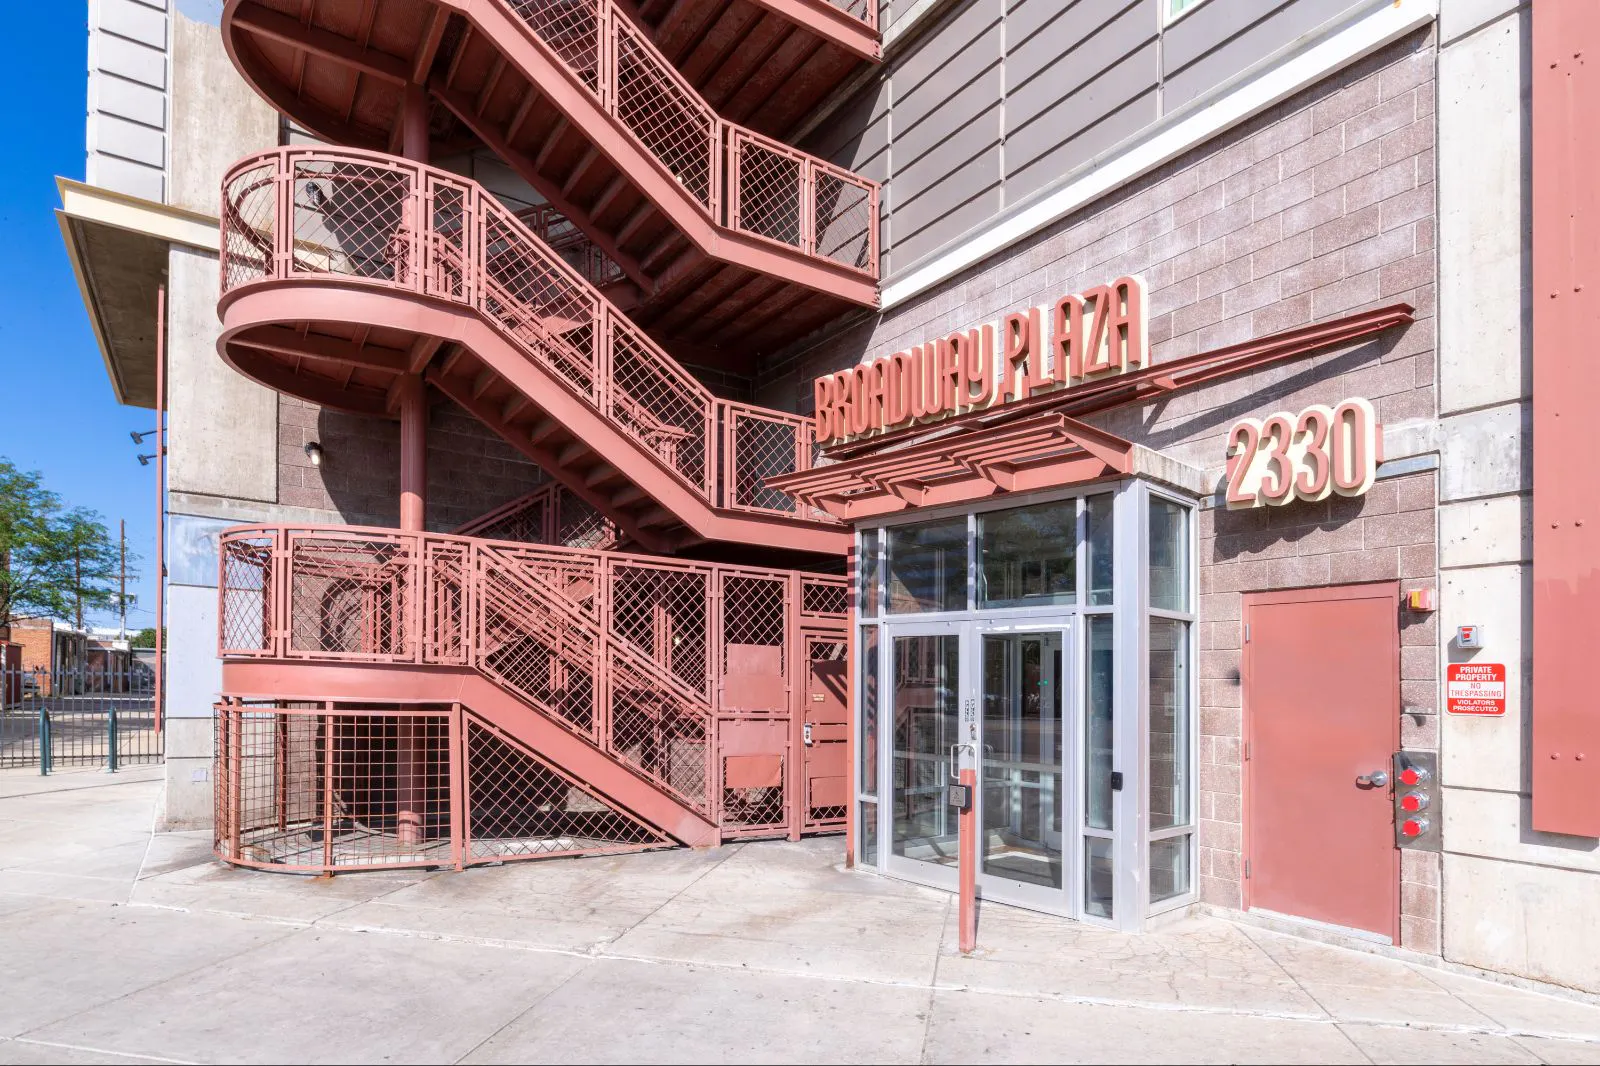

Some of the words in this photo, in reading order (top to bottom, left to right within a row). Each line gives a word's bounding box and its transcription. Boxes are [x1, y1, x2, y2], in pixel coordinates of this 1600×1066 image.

[814, 324, 997, 444] BROADWAY
[1002, 276, 1145, 403] PLAZA
[1227, 400, 1370, 506] 2330
[1455, 673, 1497, 681] PROPERTY
